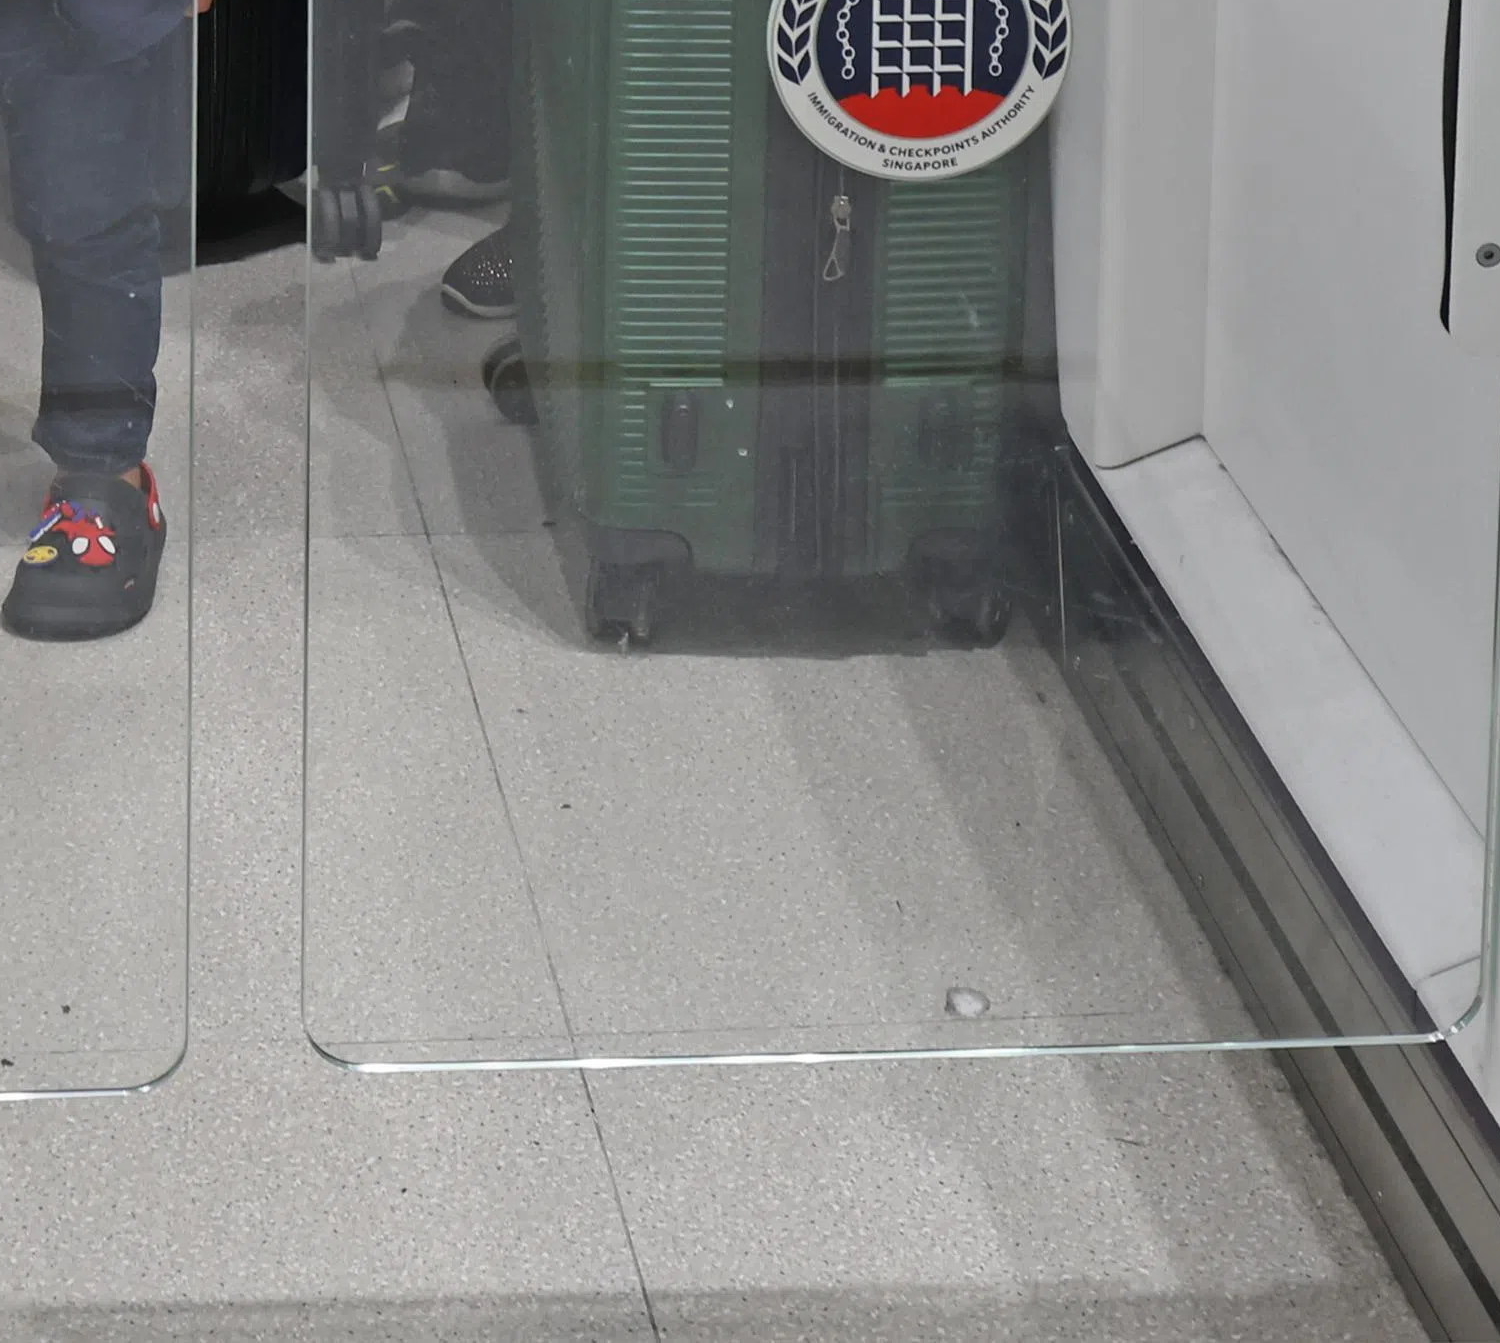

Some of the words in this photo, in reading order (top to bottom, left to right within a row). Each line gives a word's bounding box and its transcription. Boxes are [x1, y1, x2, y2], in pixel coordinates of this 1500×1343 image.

[806, 91, 877, 151] IMMIGRATION
[877, 144, 887, 154] &
[889, 136, 981, 158] CHECKPOINTS
[981, 84, 1036, 141] AUTHORITY
[881, 157, 959, 171] SINGAPORE
